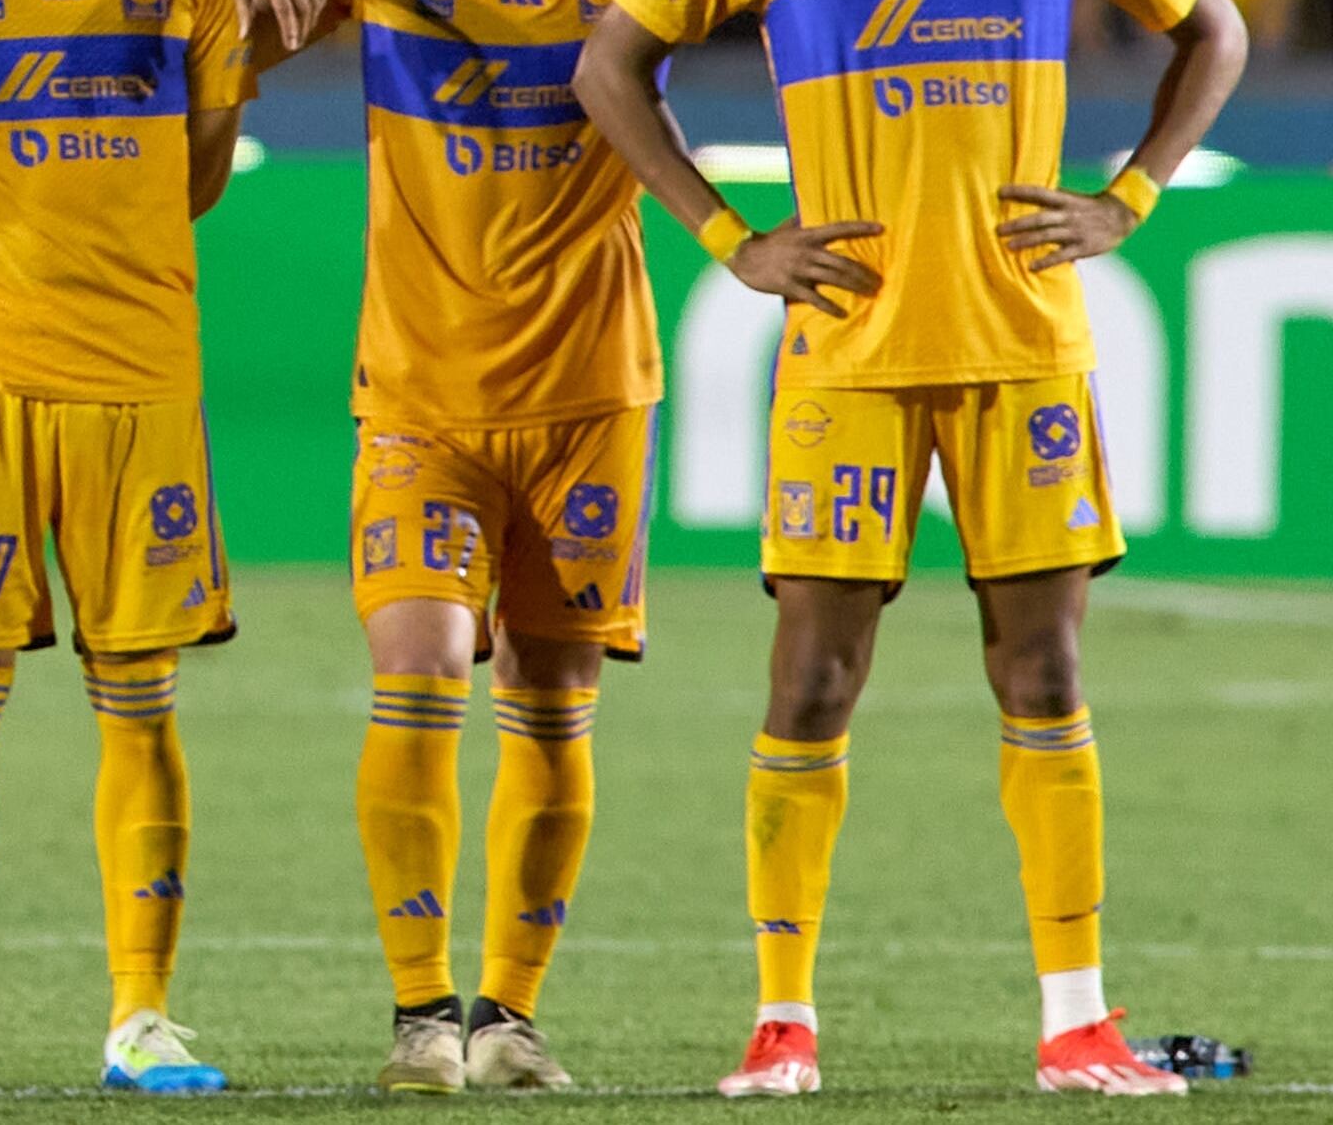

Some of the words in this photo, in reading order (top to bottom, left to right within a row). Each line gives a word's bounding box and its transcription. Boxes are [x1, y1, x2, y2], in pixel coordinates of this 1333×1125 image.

[910, 17, 1023, 43] CEMEX
[488, 82, 575, 109] CEM
[922, 75, 1010, 106] Bitso
[59, 130, 141, 160] Bitso
[492, 140, 582, 172] Bitso
[832, 464, 896, 544] 29
